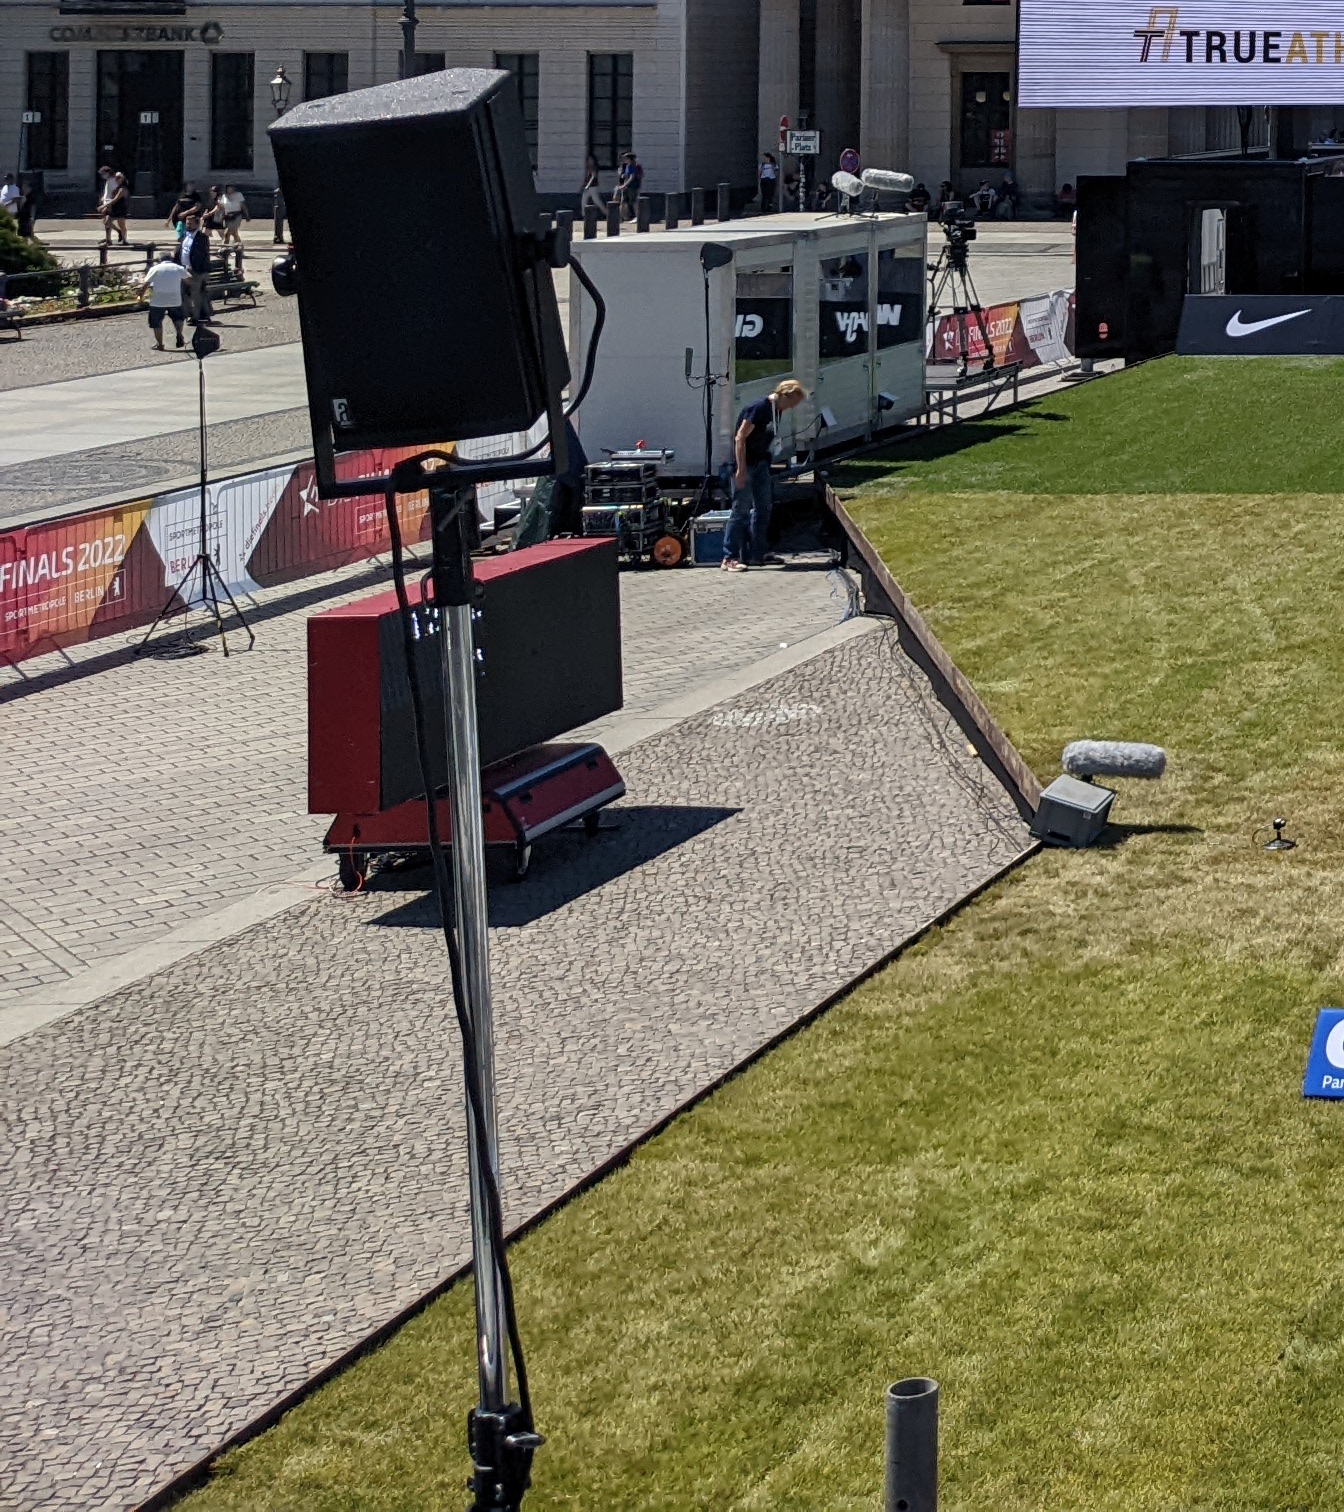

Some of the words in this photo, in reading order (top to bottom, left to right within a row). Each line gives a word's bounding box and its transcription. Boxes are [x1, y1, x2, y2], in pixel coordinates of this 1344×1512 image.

[0, 546, 75, 593] FINALS
[78, 534, 126, 572] 2022
[74, 585, 105, 604] BERLIN
